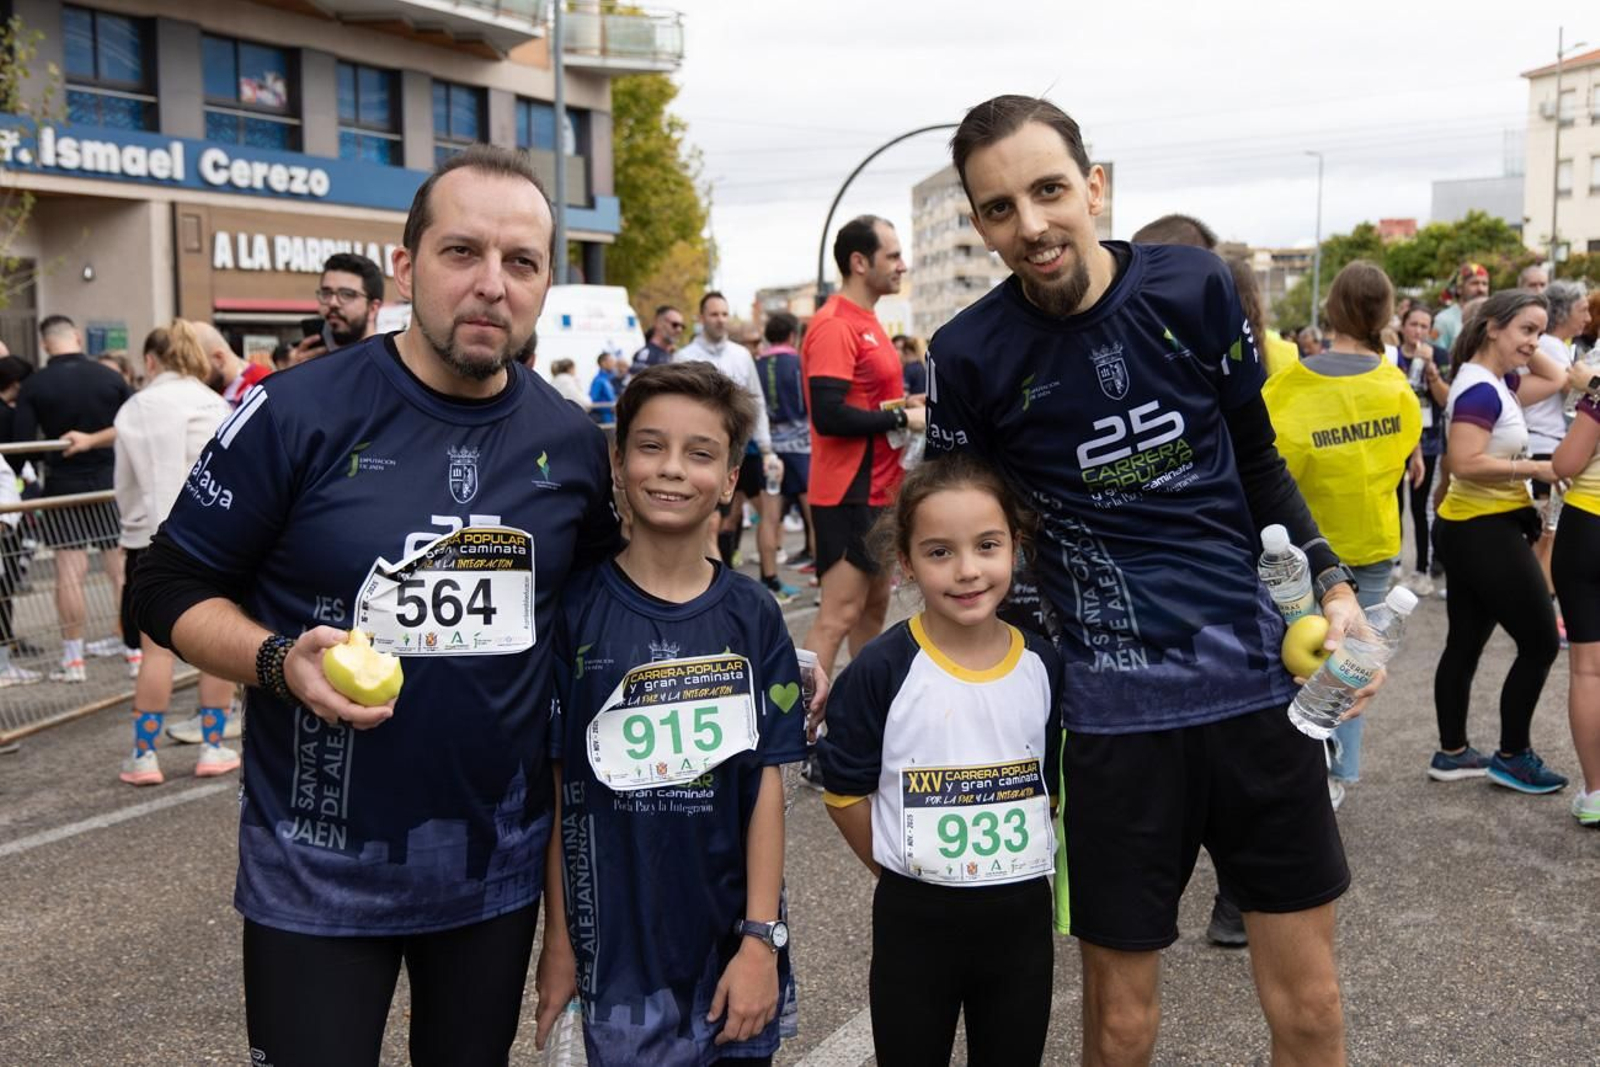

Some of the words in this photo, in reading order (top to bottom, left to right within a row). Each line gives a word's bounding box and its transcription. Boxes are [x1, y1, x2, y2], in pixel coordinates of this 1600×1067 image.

[40, 126, 185, 181] Ismael
[200, 148, 331, 197] Cerezo
[213, 231, 234, 269] A
[237, 232, 271, 271] LA
[1076, 400, 1185, 469] 25
[1081, 438, 1190, 483] CARRERA
[460, 542, 527, 555] caminata
[464, 533, 526, 546] POPULAR
[442, 557, 455, 568] LA
[313, 595, 346, 622] IES
[396, 578, 497, 628] 564
[630, 668, 684, 683] CARRERA
[687, 660, 743, 674] POPULAR
[1088, 643, 1151, 673] JAÉN
[1339, 664, 1350, 675] DE
[629, 683, 637, 694] y
[644, 678, 677, 692] gran
[684, 670, 744, 685] caminata
[627, 696, 640, 706] LA
[641, 693, 659, 704] PAZ
[667, 690, 681, 701] LA
[623, 705, 723, 760] 915
[299, 742, 319, 811] SANTA
[907, 771, 943, 793] XXV
[944, 768, 999, 782] CARRERA
[1002, 762, 1038, 777] POPULAR
[945, 782, 954, 793] y
[961, 780, 992, 792] gran
[998, 773, 1039, 786] caminata
[321, 785, 341, 817] DE
[656, 788, 715, 799] caminata
[658, 800, 667, 812] la
[925, 796, 941, 805] POR
[943, 795, 958, 805] LA
[958, 794, 975, 804] PAZ
[982, 792, 996, 802] LA
[283, 814, 348, 851] JAÉN
[937, 807, 1029, 859] 933
